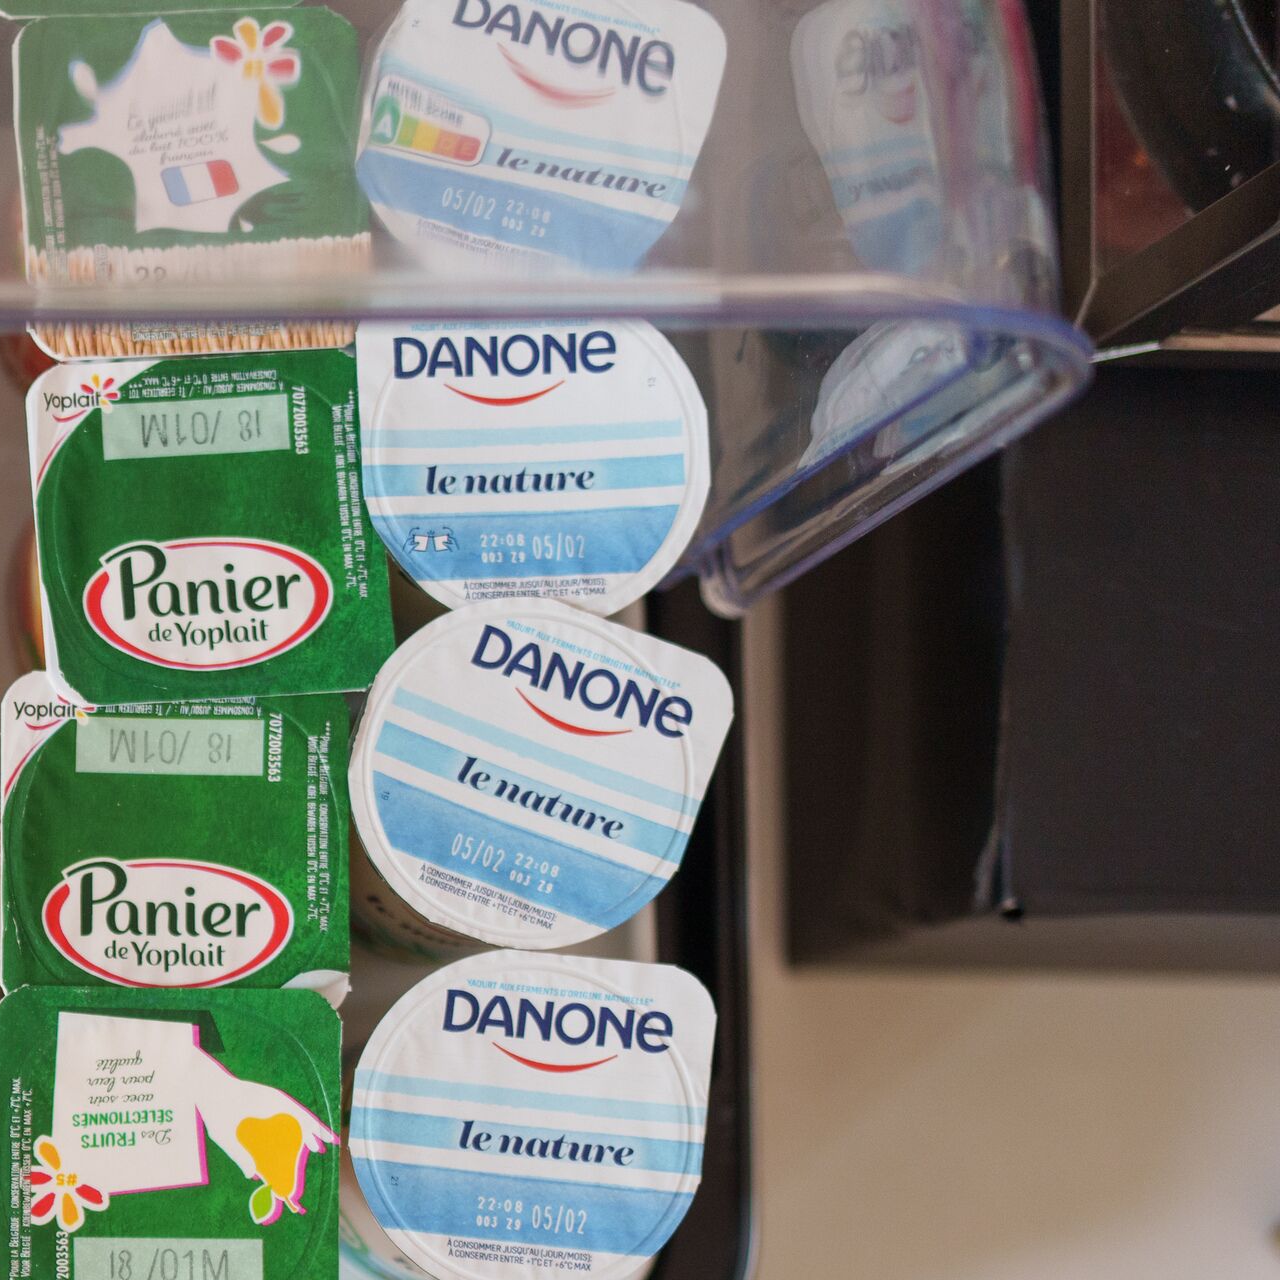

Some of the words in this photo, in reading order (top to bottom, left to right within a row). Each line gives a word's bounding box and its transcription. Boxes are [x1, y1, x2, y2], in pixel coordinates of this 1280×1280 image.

[452, 0, 675, 97] DANONE
[376, 112, 392, 139] A
[496, 147, 529, 170] le
[533, 160, 667, 200] nature
[441, 186, 496, 221] 05/02
[393, 331, 616, 379] DANONE
[43, 392, 102, 411] Yoplait
[291, 385, 309, 455] 7072003563
[426, 465, 457, 495] le
[464, 467, 595, 494] nature
[480, 534, 525, 548] 22:08
[532, 533, 586, 561] 05/02
[104, 544, 301, 621] Panier
[148, 623, 172, 642] de
[172, 619, 269, 650] Yoplait
[470, 624, 693, 738] DANONE
[13, 701, 76, 720] Yoplait
[268, 713, 284, 783] 7072003563
[457, 756, 491, 791] le
[494, 779, 625, 839] nature
[451, 833, 506, 873] 05/02
[515, 852, 561, 878] 22:08
[64, 861, 261, 938] Panier
[427, 866, 473, 889] CONSOMMER
[473, 882, 508, 903] JUSQU'AU
[425, 875, 467, 900] CONSERVER
[467, 892, 491, 907] ENTRE
[508, 907, 518, 917] ET
[536, 917, 554, 930] MAX
[104, 939, 129, 960] de
[130, 941, 226, 972] Yoplait
[467, 978, 497, 988] YAOURT
[515, 983, 559, 997] FERMENTS
[443, 989, 673, 1053] DANONE
[96, 1050, 143, 1074] qualité
[122, 1070, 155, 1084] pour
[86, 1076, 116, 1093] leur
[88, 1094, 119, 1106] soin
[123, 1093, 154, 1103] avec
[72, 1109, 173, 1127] SÉLECTIONNÉS
[81, 1131, 136, 1149] FRUITS
[141, 1129, 172, 1146] Des
[458, 1120, 493, 1151] le
[498, 1134, 635, 1167] nature
[476, 1215, 498, 1229] 003
[506, 1217, 522, 1231] 29
[477, 1196, 524, 1214] 22:08
[532, 1204, 588, 1235] 05/02
[454, 1240, 502, 1253] CONSOMMER
[502, 1246, 540, 1257] JUSQU'AU
[455, 1251, 499, 1262] CONSERVER
[500, 1254, 525, 1265] ENTRE
[543, 1259, 553, 1268] ET
[574, 1262, 592, 1272] MAX
[110, 1249, 132, 1280] 18
